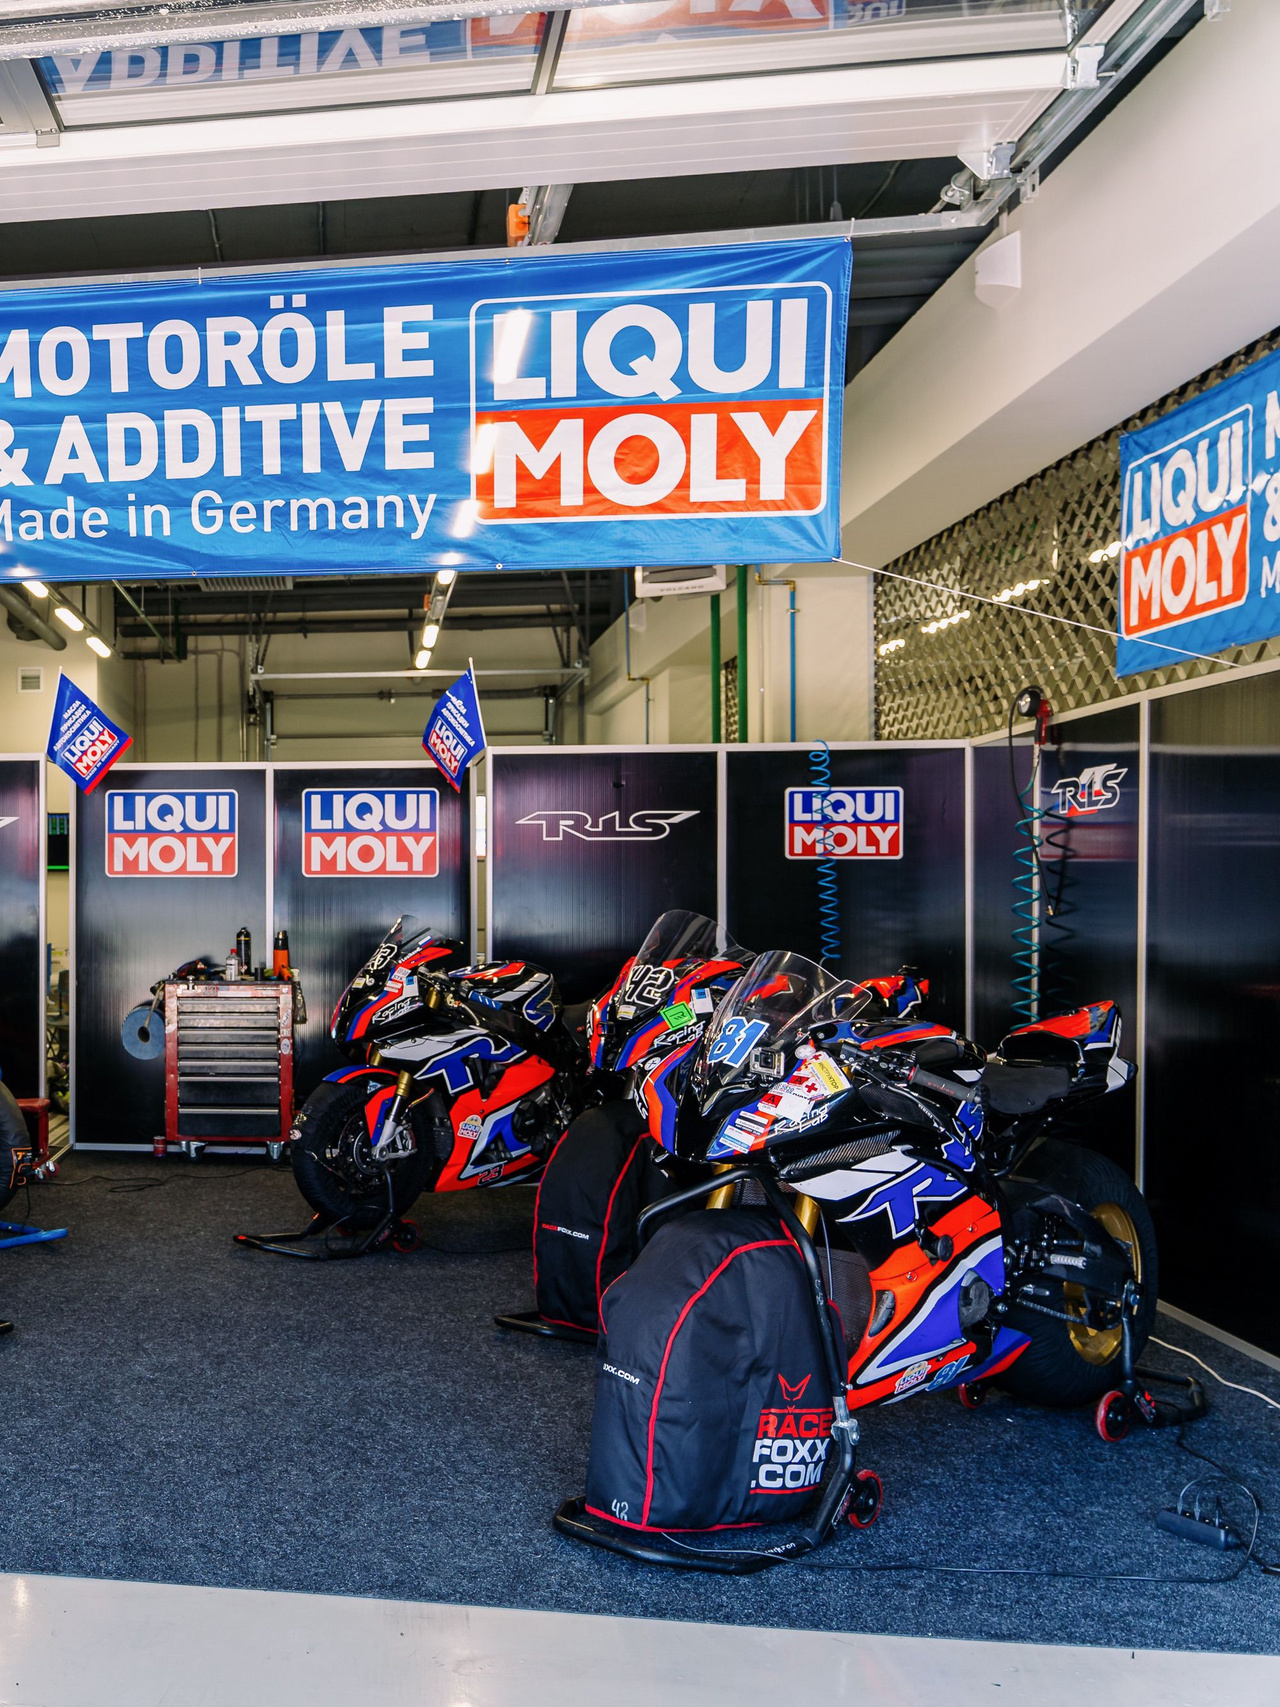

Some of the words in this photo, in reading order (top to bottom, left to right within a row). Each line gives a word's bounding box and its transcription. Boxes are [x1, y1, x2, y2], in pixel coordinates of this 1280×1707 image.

[492, 298, 809, 402] LIQUI
[45, 397, 435, 486] ADDITIVE
[492, 410, 818, 509] MOLY
[1132, 420, 1244, 541] LIQUI
[128, 494, 171, 537] in
[191, 491, 437, 540] Germany
[1129, 513, 1247, 627] MOLY
[60, 704, 87, 733] ПРИСАДКИ
[63, 700, 81, 719] МАСЛА
[53, 709, 92, 751] АВТОКОСМЕТИКА
[64, 720, 104, 763] LIQUI
[435, 720, 465, 759] LIQUI
[75, 729, 114, 774] MOLY
[430, 732, 459, 771] MOLY
[113, 794, 230, 833] LIQUI
[310, 793, 431, 832] LIQUI
[793, 791, 896, 823] LIQUI
[113, 836, 234, 873] MOLY
[310, 835, 435, 872] MOLY
[793, 826, 899, 856] MOLY
[653, 1020, 706, 1048] Racing
[707, 1016, 770, 1068] 81
[460, 1129, 478, 1138] MOLY
[463, 1122, 479, 1131] LIQUI
[774, 1102, 831, 1135] Racing
[478, 1164, 505, 1186] 23
[896, 1375, 925, 1392] MOLY
[900, 1368, 926, 1386] LIQUI
[925, 1355, 970, 1392] 81
[757, 1414, 833, 1438] RACE
[752, 1438, 830, 1463] FOXX
[751, 1461, 824, 1488] .COM
